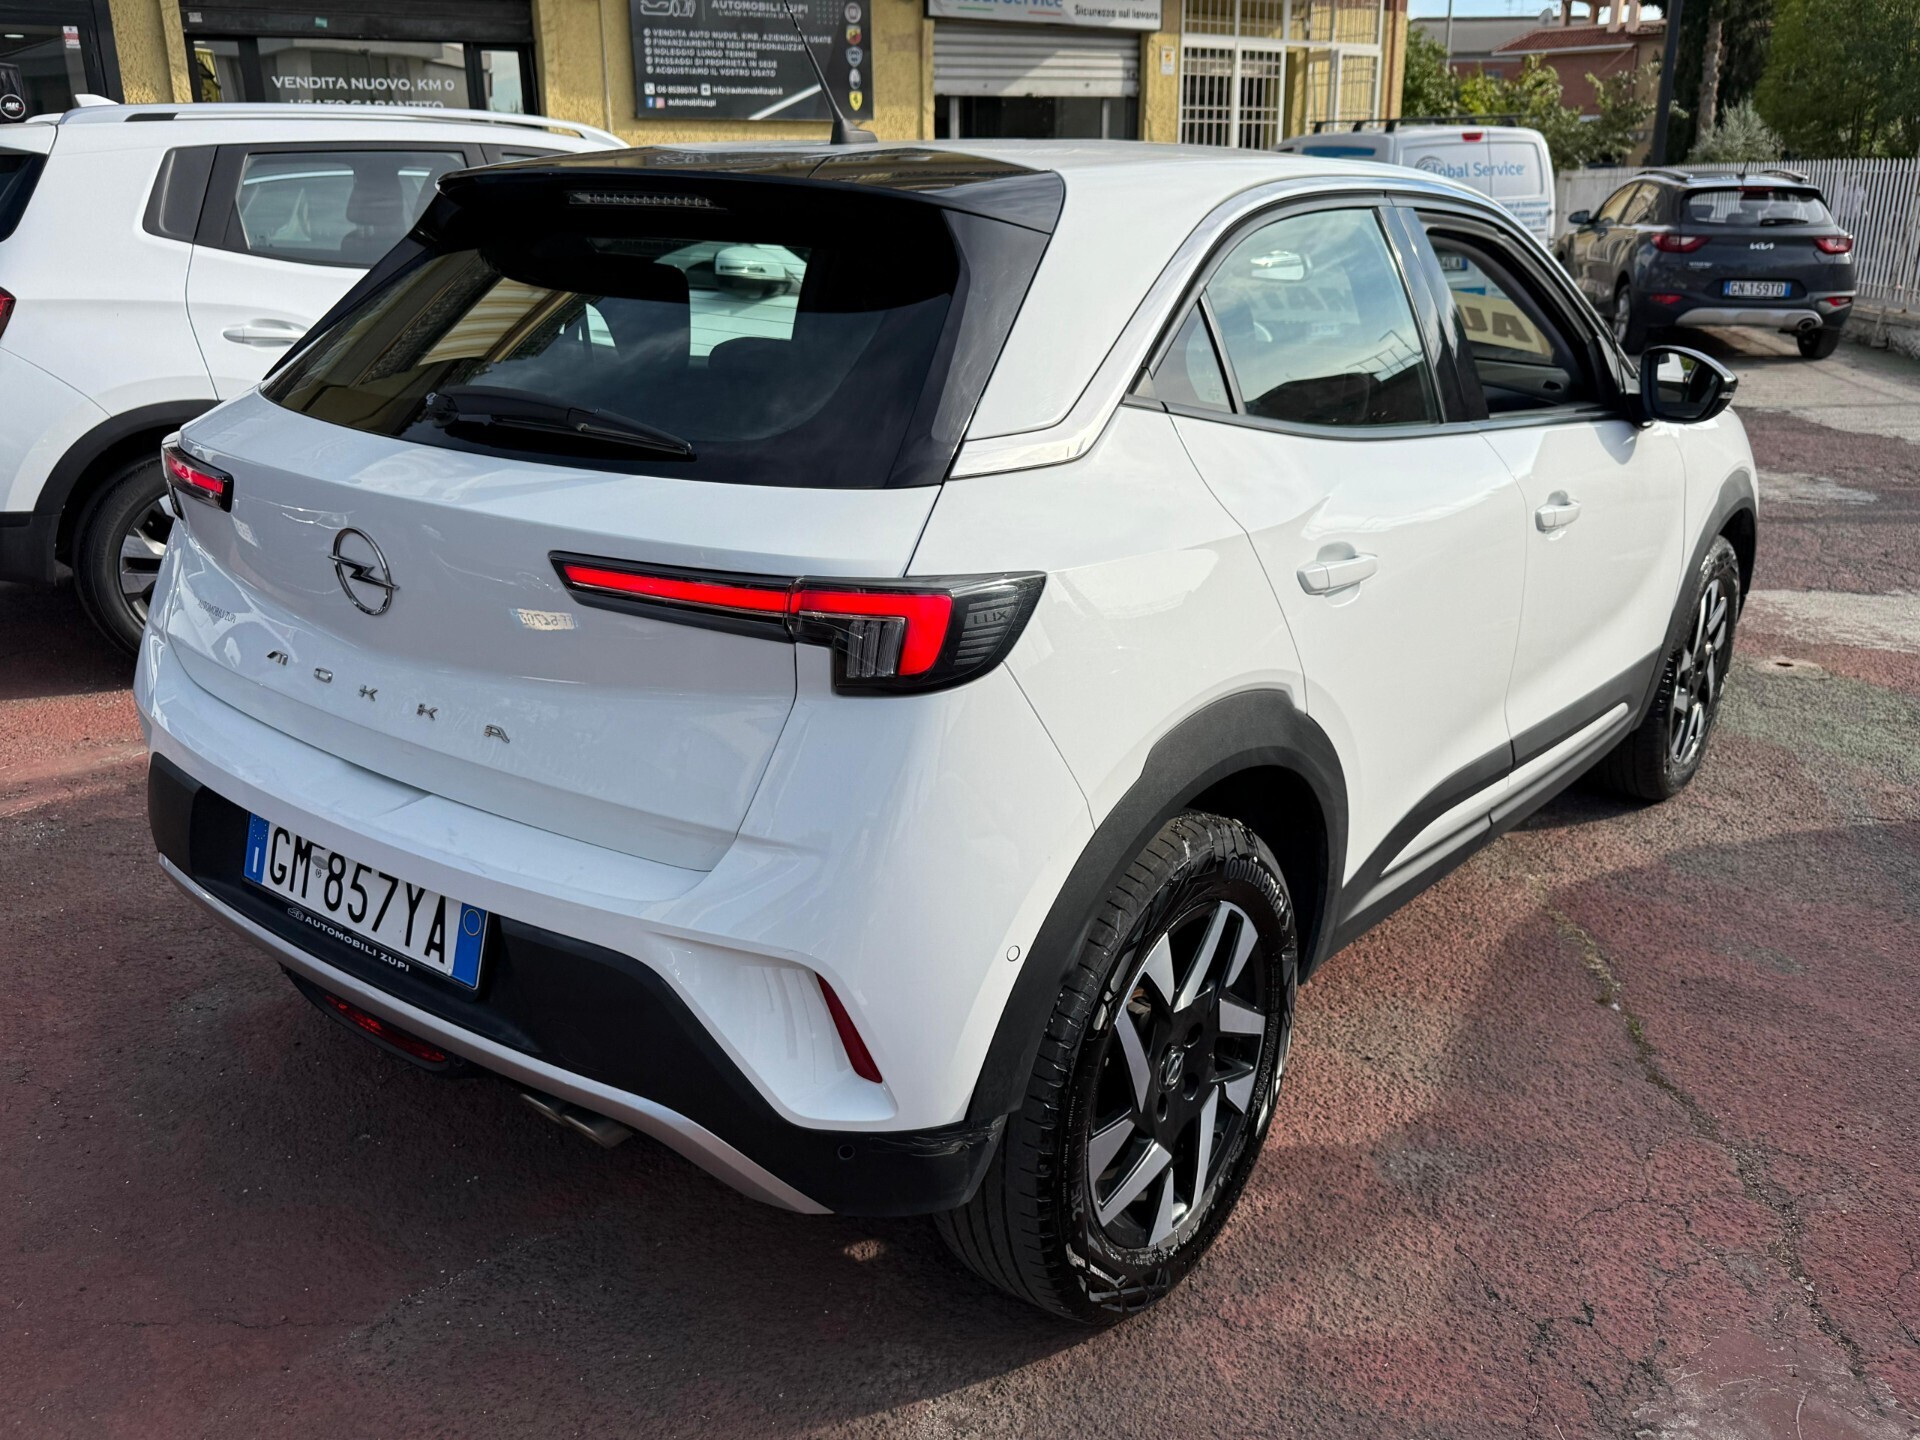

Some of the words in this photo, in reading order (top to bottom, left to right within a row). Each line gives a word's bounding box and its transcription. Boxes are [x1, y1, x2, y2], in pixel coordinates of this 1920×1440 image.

[712, 0, 780, 11] AUTOMOBILI
[747, 42, 807, 51] PERSONALIZZA
[272, 76, 348, 90] VENDITA
[351, 77, 414, 92] NUOVO,
[417, 79, 442, 91] KM
[1473, 161, 1524, 177] Service
[267, 650, 510, 744] MOKKA
[304, 916, 377, 957] AUTOMOBILI
[380, 951, 410, 973] ZUPI
